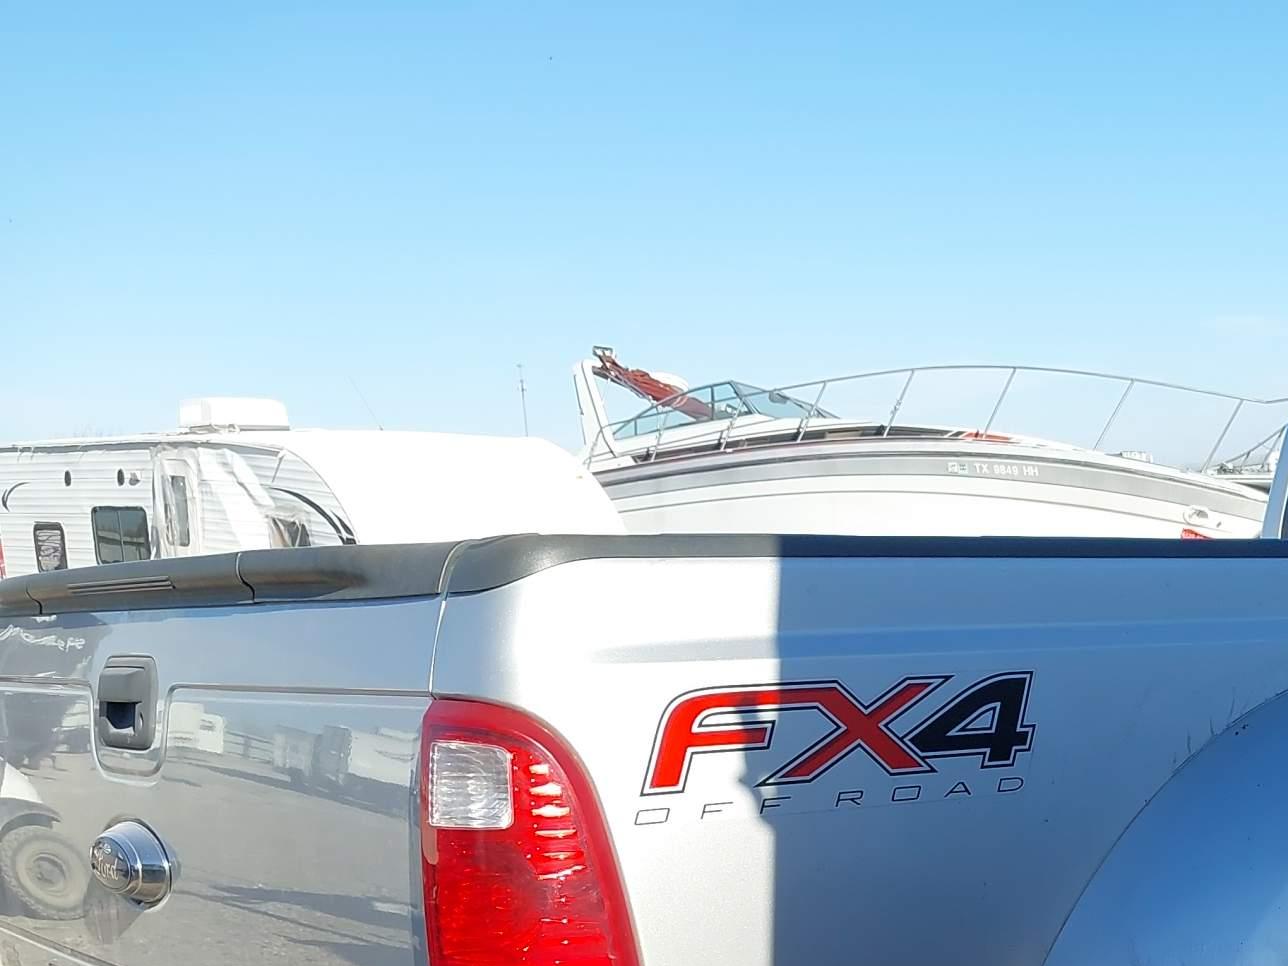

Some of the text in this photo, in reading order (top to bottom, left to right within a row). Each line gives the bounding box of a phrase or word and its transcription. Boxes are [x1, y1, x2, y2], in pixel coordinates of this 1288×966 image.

[974, 463, 990, 475] TX
[640, 670, 1037, 797] FX4
[634, 776, 1025, 826] OFF ROAD
[93, 844, 119, 881] Ford
